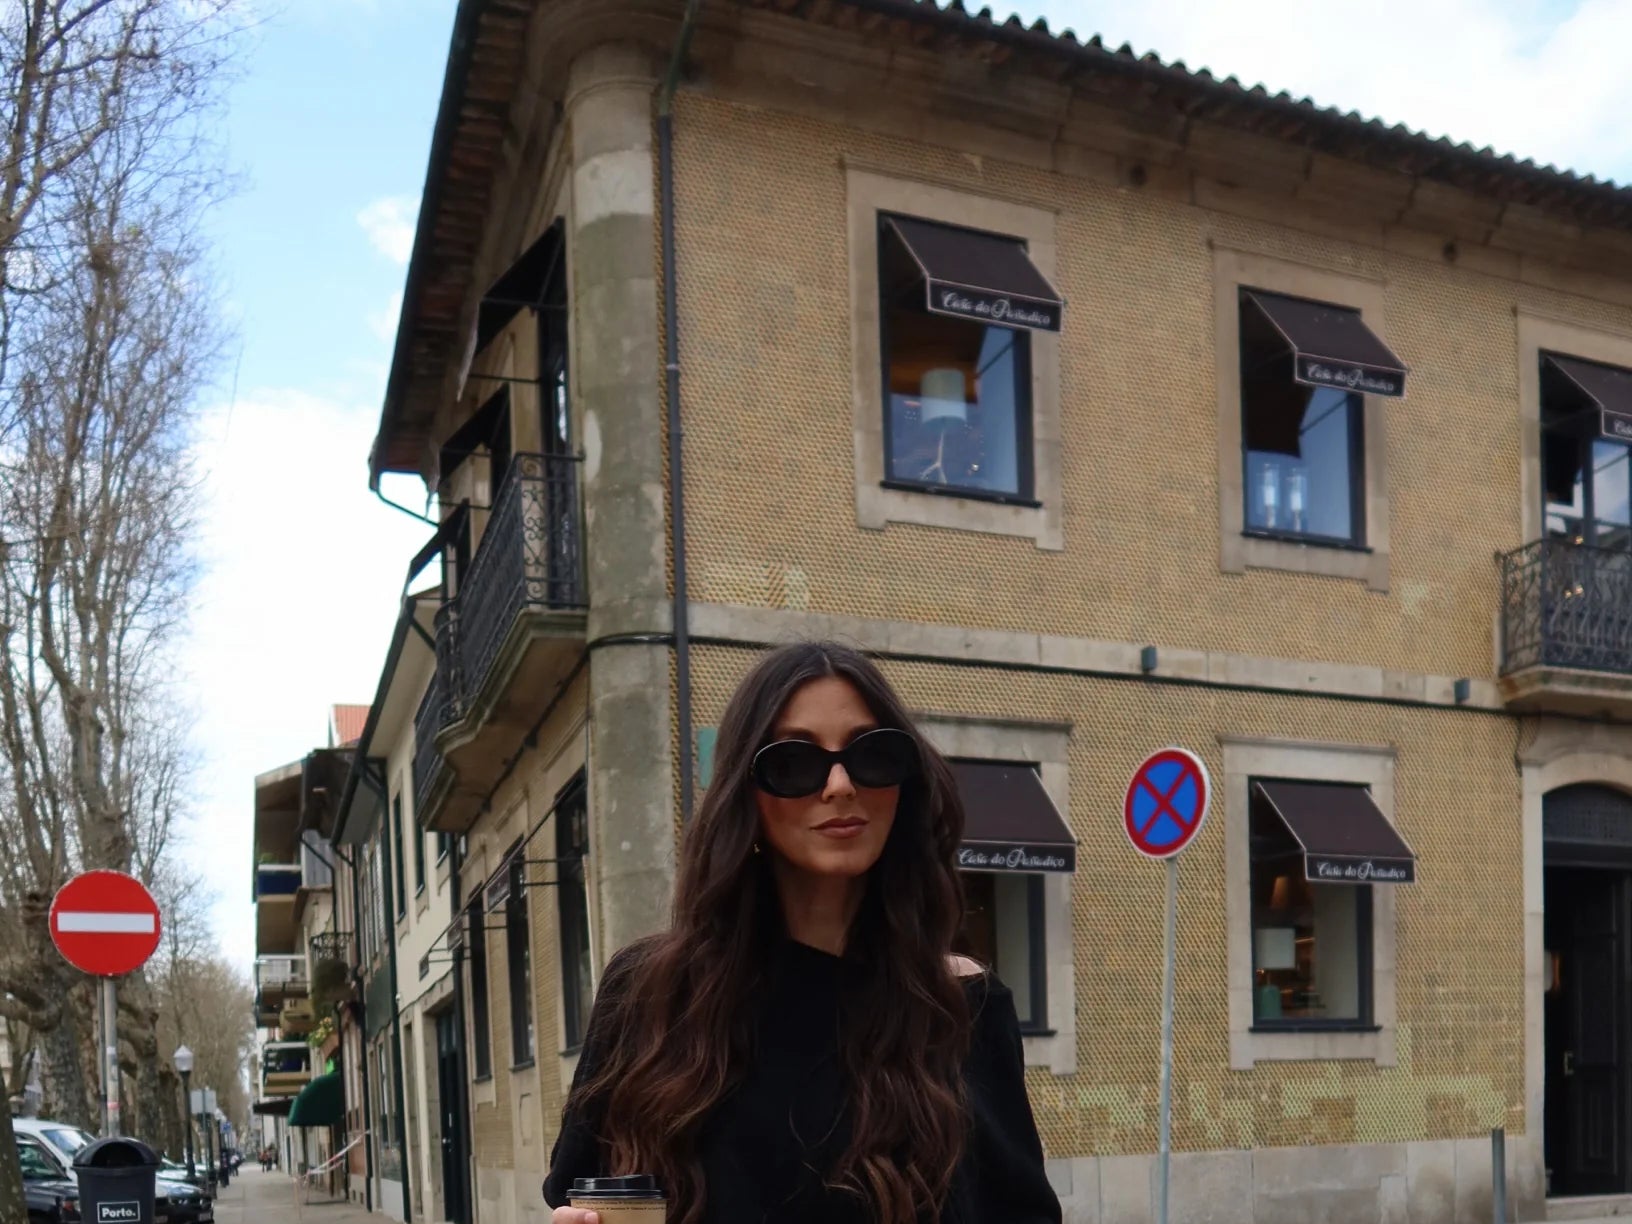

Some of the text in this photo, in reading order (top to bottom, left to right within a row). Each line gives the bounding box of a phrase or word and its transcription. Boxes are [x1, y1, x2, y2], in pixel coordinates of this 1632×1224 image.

[943, 291, 971, 310] Casa
[958, 848, 988, 864] Casa
[991, 853, 1005, 865] do
[102, 1207, 136, 1218] Porto.
